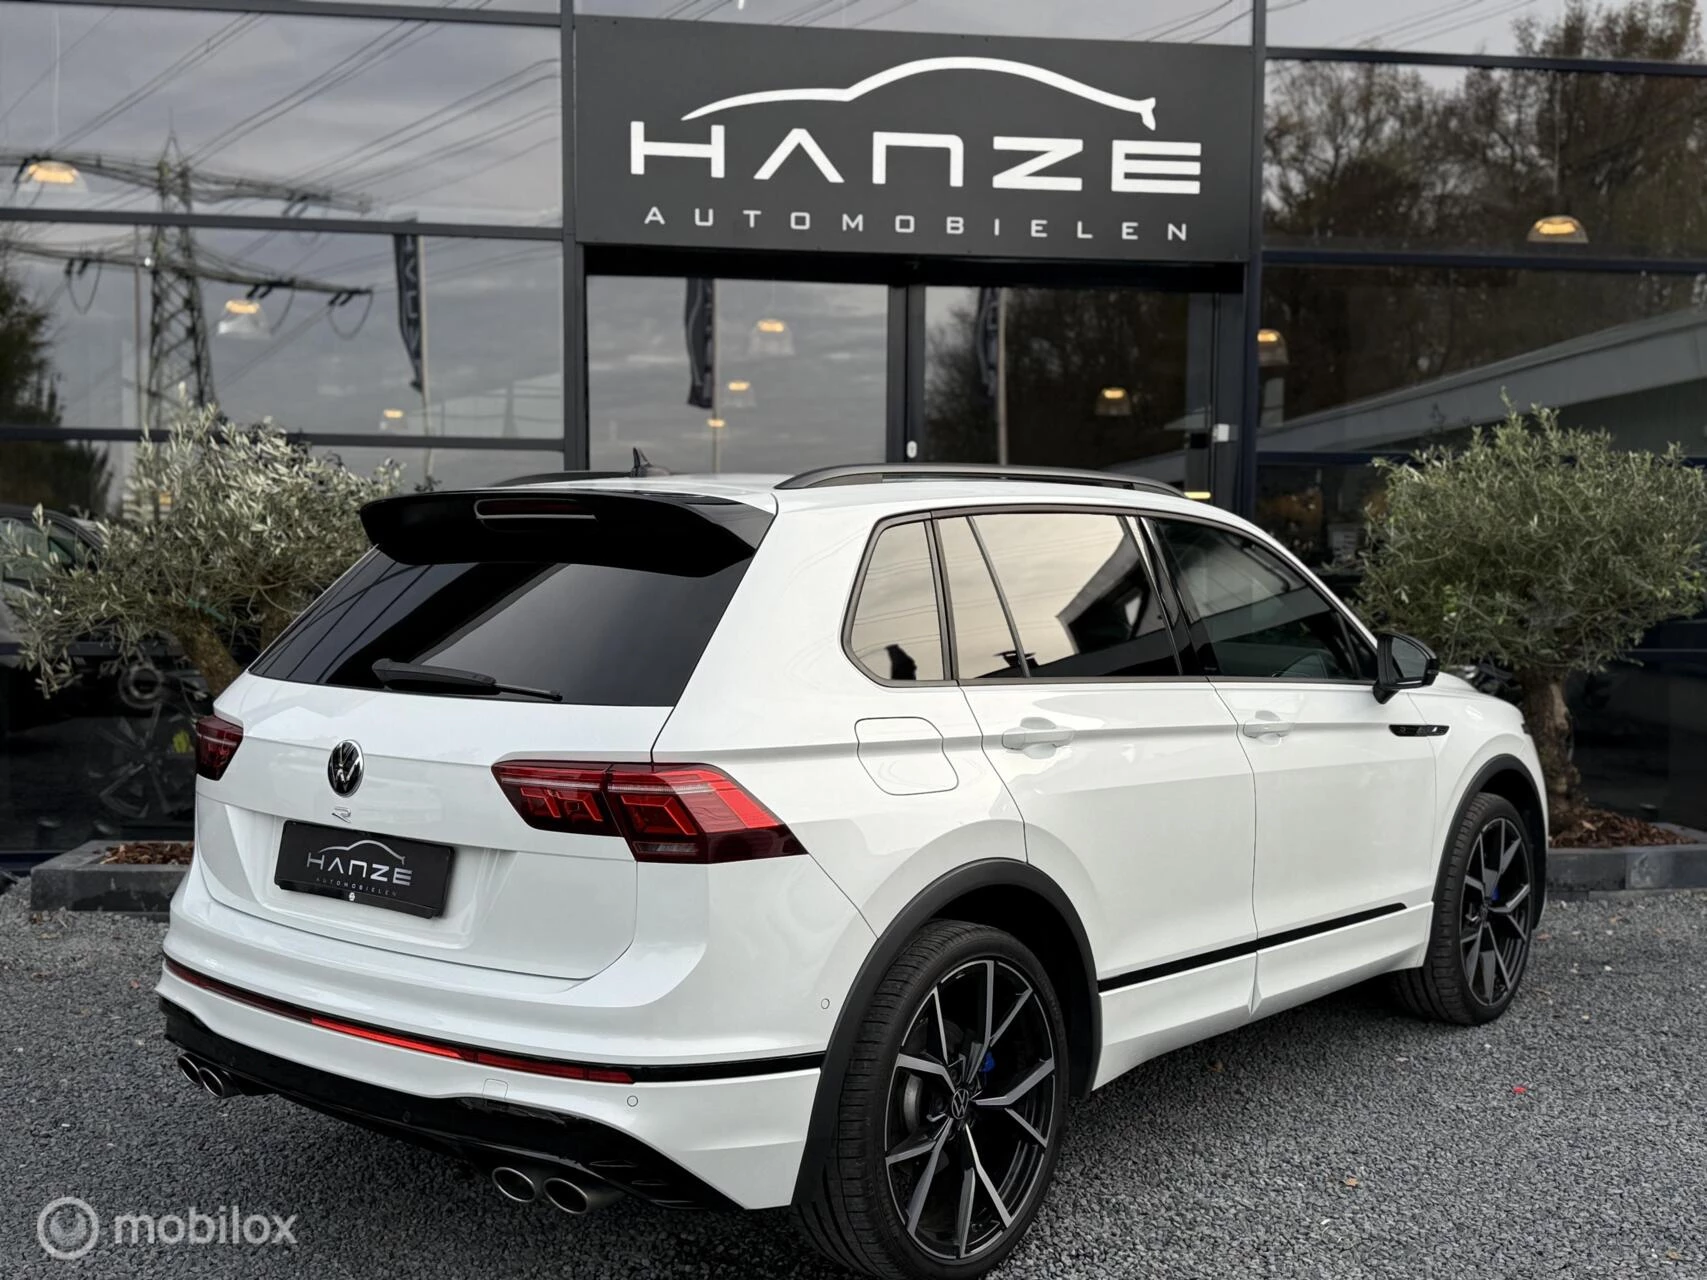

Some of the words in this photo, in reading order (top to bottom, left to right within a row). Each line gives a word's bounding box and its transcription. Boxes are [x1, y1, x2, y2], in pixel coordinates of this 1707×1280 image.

[630, 121, 1202, 195] HANZE
[644, 206, 1188, 242] AUTOMOBIELEN
[306, 852, 413, 887] HANZE
